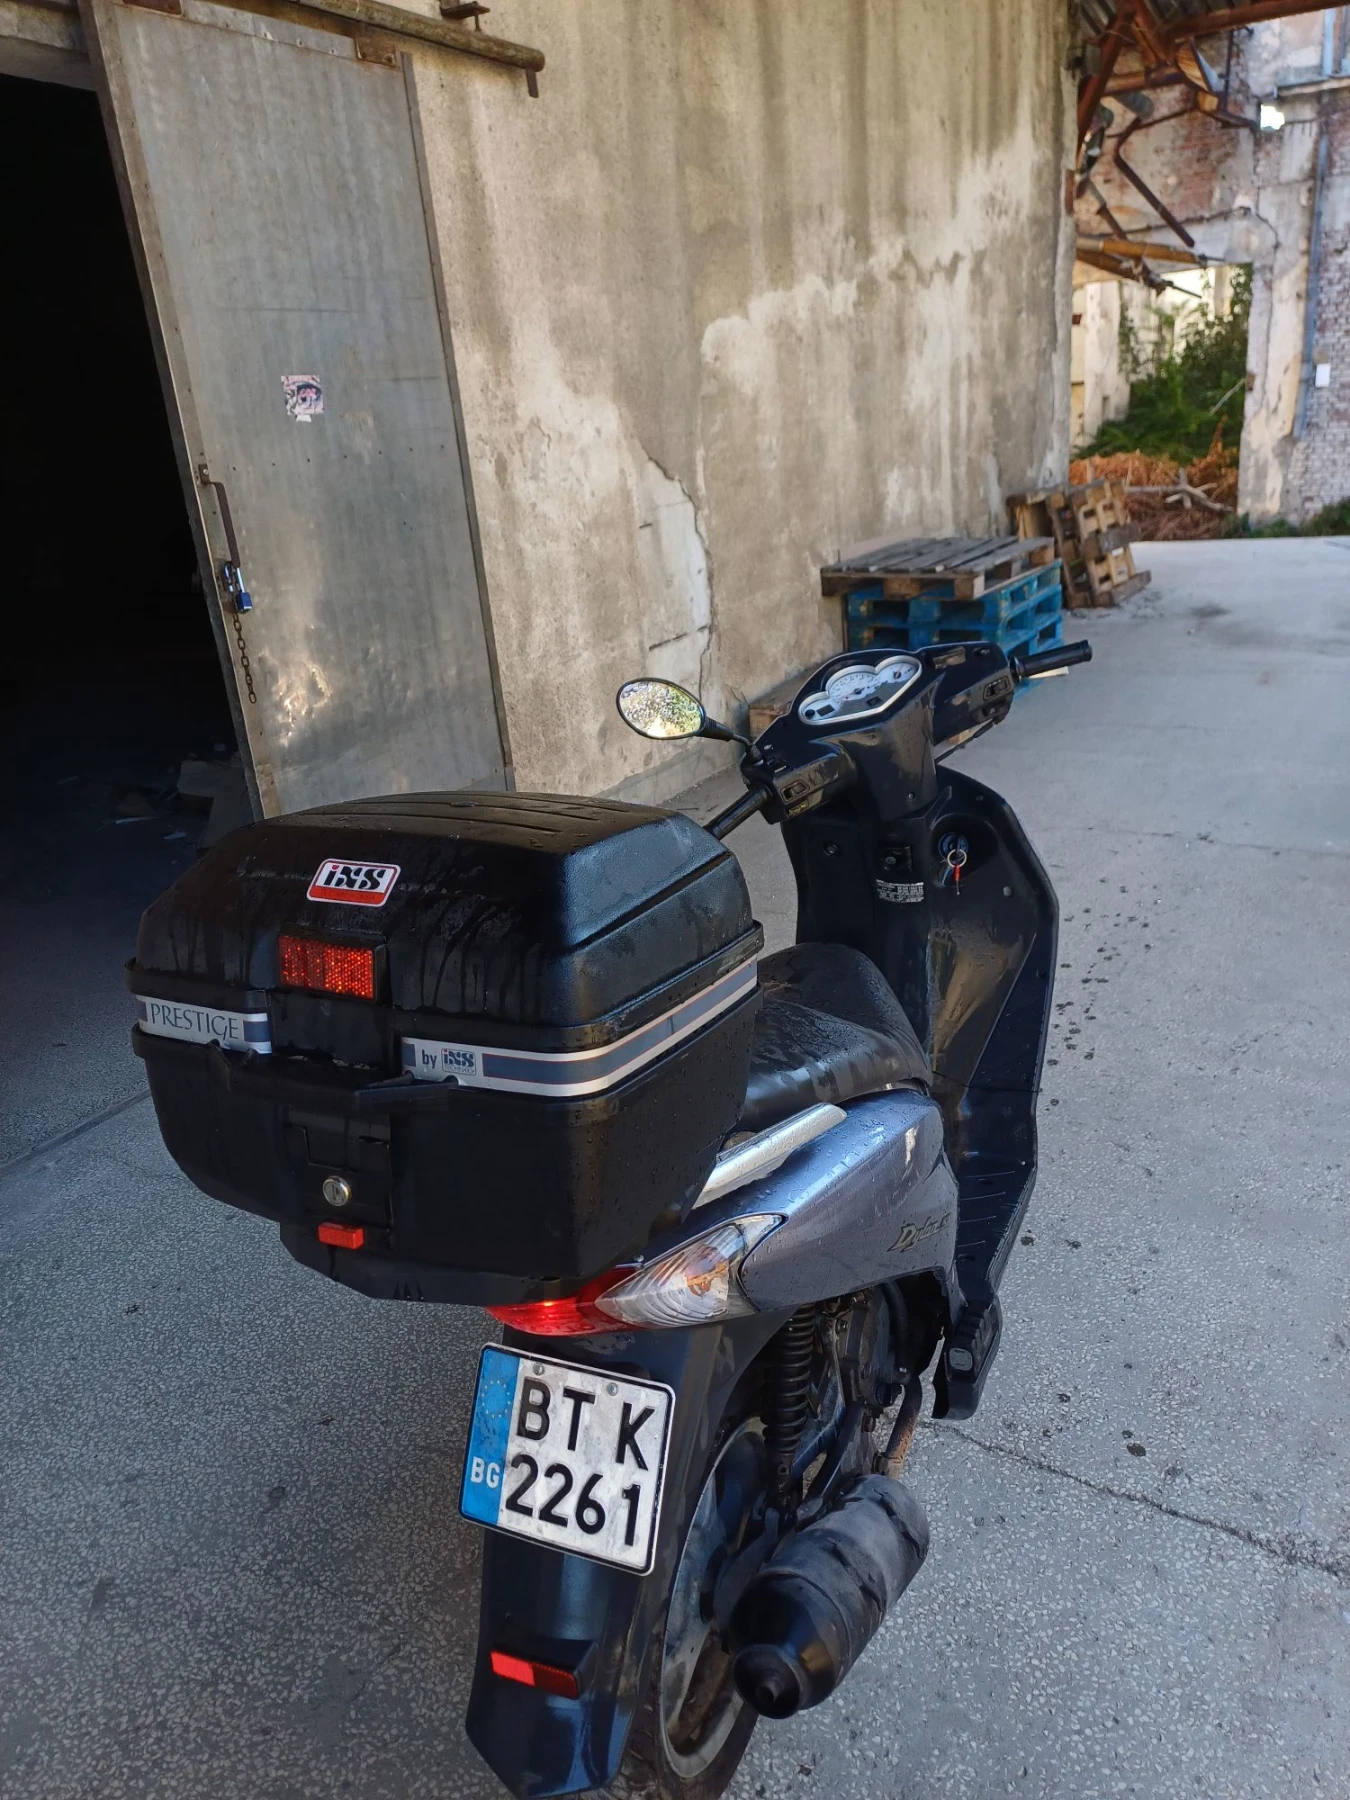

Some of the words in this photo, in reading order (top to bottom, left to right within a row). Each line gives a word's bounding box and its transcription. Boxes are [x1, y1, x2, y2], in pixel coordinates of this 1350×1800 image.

[150, 1003, 239, 1040] PRESTIGE
[421, 1049, 438, 1070] by
[470, 1456, 500, 1488] BG
[505, 1453, 641, 1547] 2261
